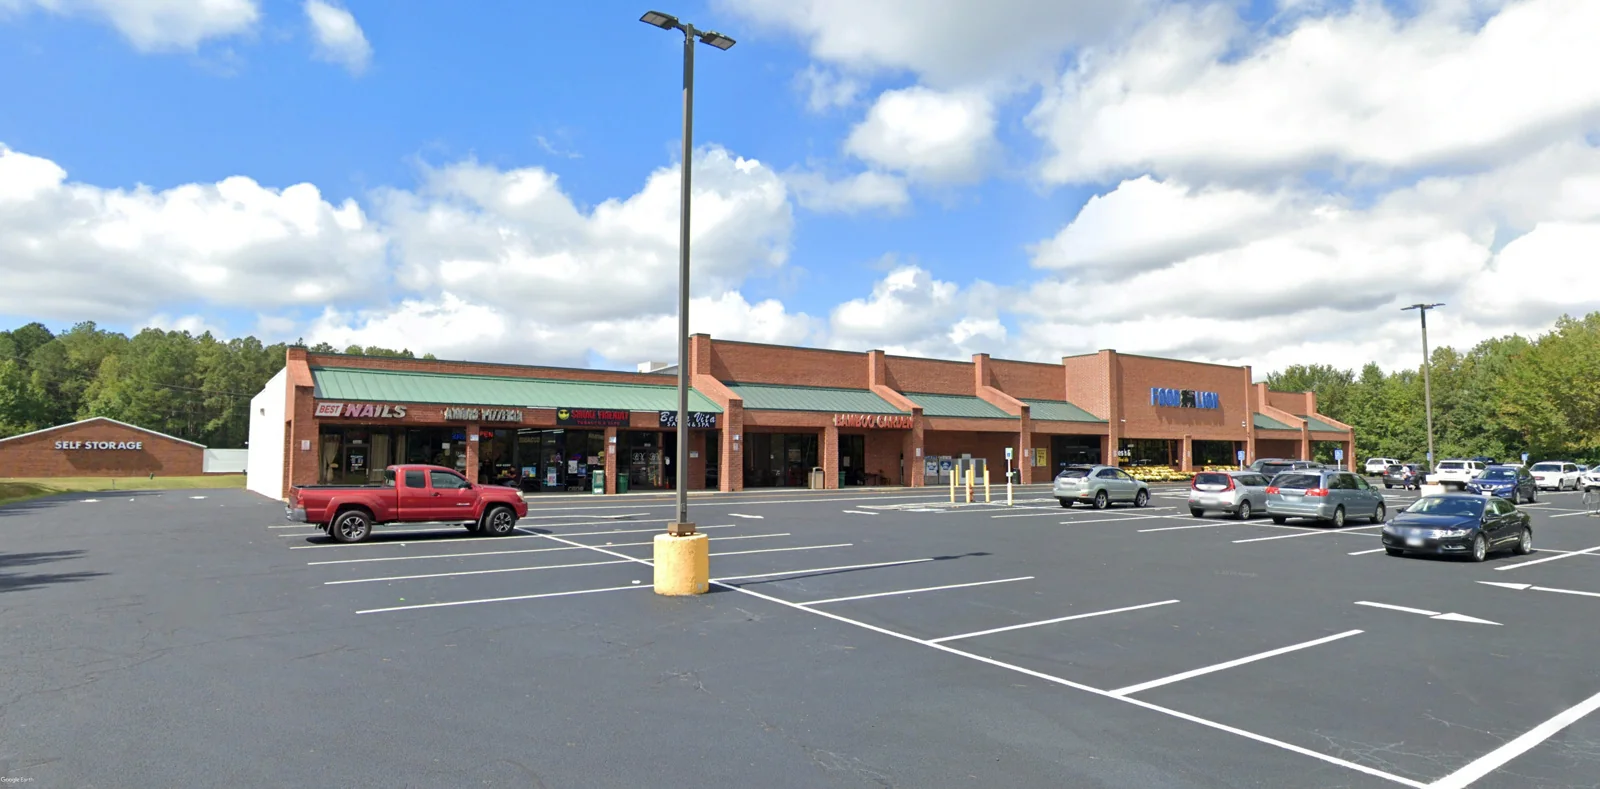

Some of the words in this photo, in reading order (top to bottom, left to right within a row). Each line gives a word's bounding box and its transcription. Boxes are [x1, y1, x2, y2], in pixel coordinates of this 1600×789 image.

[1150, 387, 1180, 407] FOOD
[1195, 391, 1219, 408] LION
[320, 405, 340, 413] BEST
[344, 403, 407, 418] NAILS
[571, 410, 595, 419] SMOKE
[660, 412, 690, 422] Bel
[694, 412, 716, 422] Vita
[834, 414, 875, 427] BAMBOO
[877, 415, 913, 429] GARDEN
[55, 441, 82, 450] SELF
[84, 441, 142, 450] STORAGE
